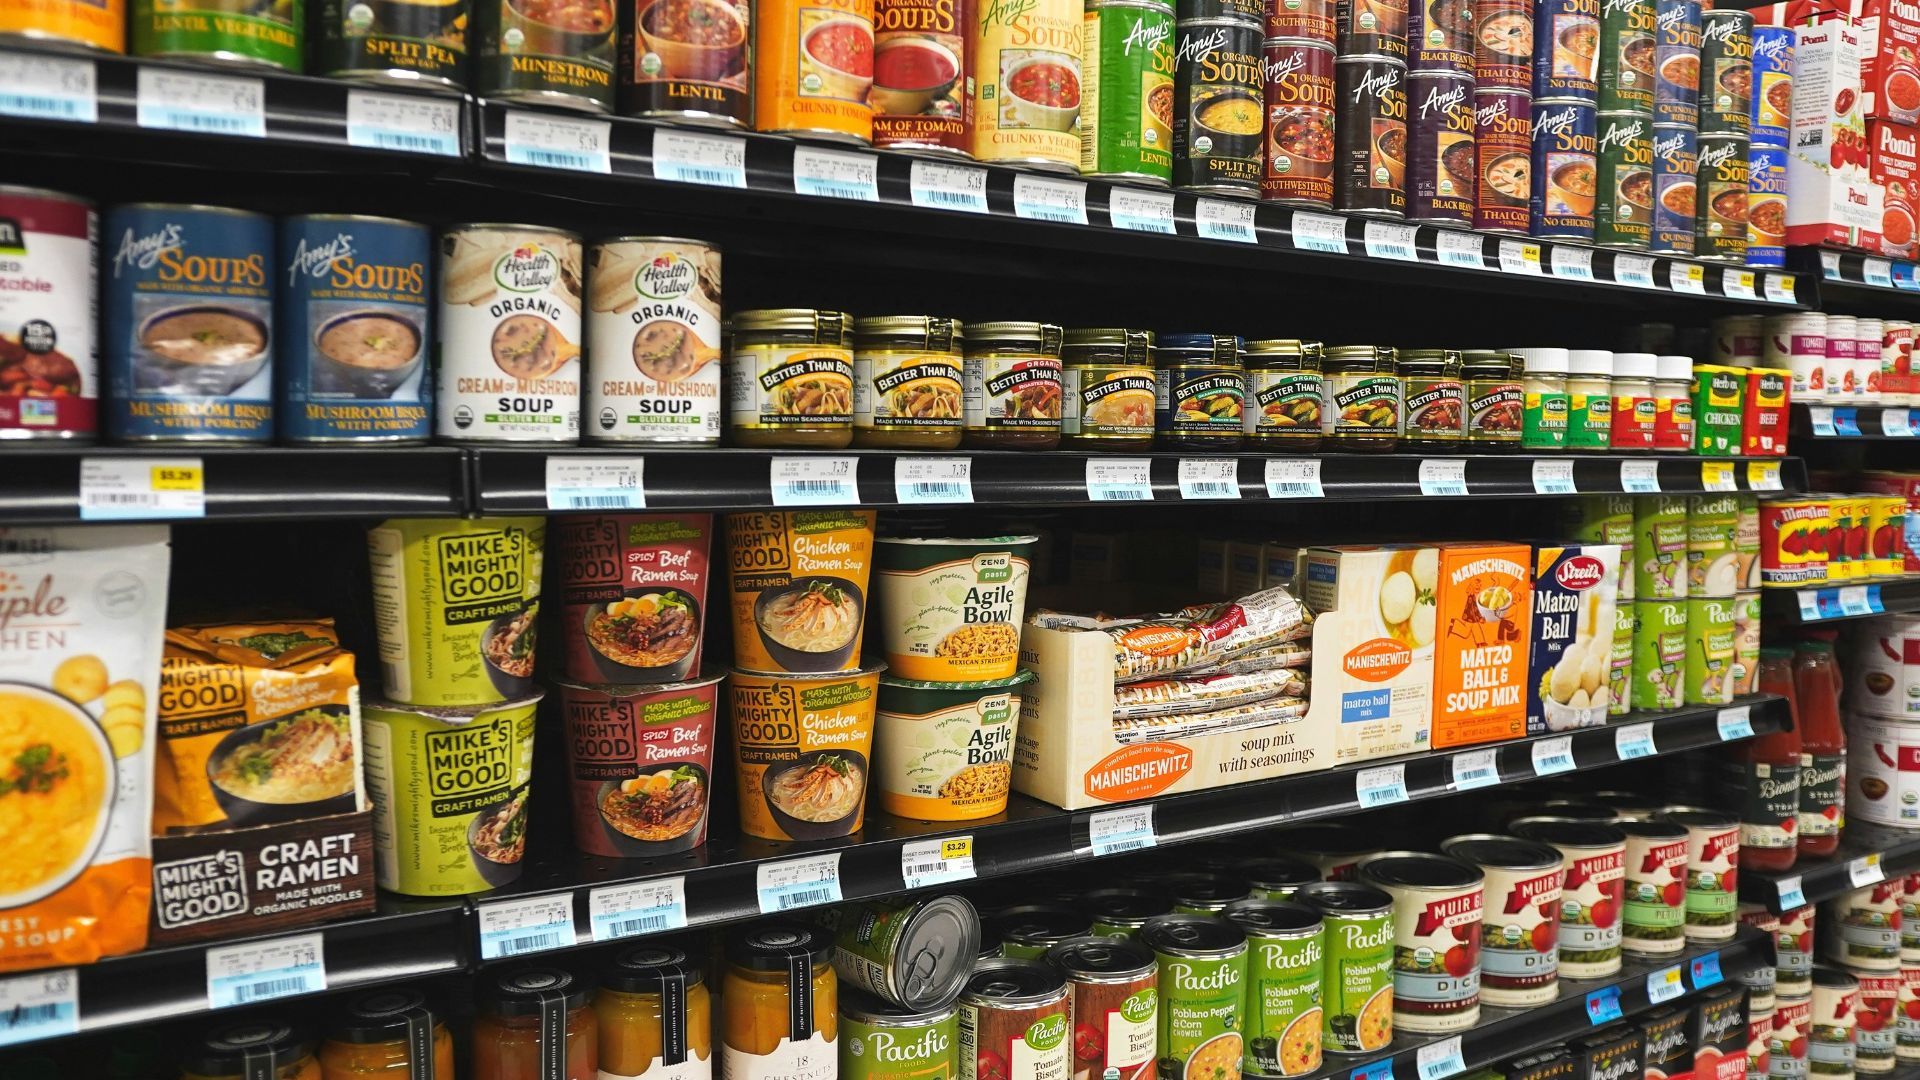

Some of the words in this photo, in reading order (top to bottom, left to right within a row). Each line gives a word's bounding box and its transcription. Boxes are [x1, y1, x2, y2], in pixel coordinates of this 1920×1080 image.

[1011, 15, 1082, 57] SOUPS
[1702, 17, 1743, 48] Amy's
[366, 38, 419, 57] SPLIT
[427, 43, 455, 64] PEA
[1753, 34, 1788, 57] Amy's
[1420, 51, 1447, 62] BLACK
[512, 56, 608, 86] MINESTRONE
[668, 82, 726, 101] LENTIL
[1353, 68, 1401, 104] Amy's
[792, 101, 838, 116] CHUNKY
[896, 121, 913, 131] OF
[915, 122, 964, 135] TOMATO
[1599, 120, 1643, 153] Amy's
[992, 132, 1043, 144] CHUNKY
[1210, 159, 1245, 171] SPLIT
[1247, 161, 1261, 174] PEA
[856, 172, 873, 185] 5.19
[967, 175, 982, 188] 5.19
[1261, 180, 1320, 194] SOUTHWESTERN
[1064, 195, 1078, 209] 5.19
[1432, 199, 1457, 210] BLACK
[1240, 210, 1252, 219] 5.19
[1483, 211, 1511, 221] THAI
[159, 247, 266, 286] SOUPS
[644, 263, 688, 281] Health
[331, 257, 423, 294] SOUPS
[654, 278, 692, 296] Valley
[490, 298, 561, 321] ORGANIC
[632, 305, 699, 326] ORGANIC
[762, 364, 804, 388] BETTER
[806, 360, 834, 373] THAN
[878, 370, 918, 394] BETTER
[989, 374, 1030, 394] BETTER
[1031, 369, 1052, 380] THAN
[458, 378, 503, 394] CREAM
[603, 380, 646, 396] CREAM
[657, 381, 717, 399] MUSHROOM
[1085, 383, 1121, 402] BETTER
[1123, 379, 1144, 390] THAN
[1176, 382, 1212, 399] BETTER
[1213, 378, 1235, 389] THAN
[499, 398, 553, 413] SOUP
[640, 400, 692, 414] SOUP
[1409, 394, 1439, 409] BETTER
[497, 415, 530, 423] GLUTEN
[532, 415, 553, 423] FREE
[639, 416, 669, 424] GLUTEN
[671, 416, 693, 424] FREE
[1704, 414, 1741, 425] CHICKEN
[1759, 414, 1779, 425] BEEF
[160, 470, 192, 481] $5.29
[832, 462, 849, 473] 7.79
[952, 465, 967, 476] 7.79
[1221, 466, 1233, 477] 5.69
[1134, 474, 1147, 484] 5.99
[445, 533, 520, 559] MIKE'S
[793, 537, 850, 556] Chicken
[447, 553, 520, 577] MIGHTY
[659, 551, 691, 567] Beef
[733, 548, 785, 568] GOOD
[797, 555, 843, 571] Ramen
[980, 558, 1006, 566] ZENB
[631, 568, 679, 582] Ramen
[680, 570, 699, 583] Soup
[985, 570, 1007, 579] pasta
[1451, 558, 1526, 585] MANISCHEWITZ
[450, 570, 520, 598] GOOD
[964, 586, 1014, 607] Agile
[1535, 591, 1578, 614] Matzo
[447, 609, 487, 621] CRAFT
[488, 602, 522, 615] RAMEN
[964, 605, 1012, 624] Bowl
[1542, 615, 1569, 641] Ball
[1548, 643, 1561, 651] Mix
[980, 657, 1001, 665] STREET
[1346, 650, 1411, 670] MANISCHEWITZ
[1460, 646, 1513, 669] MATZO
[1463, 669, 1499, 690] BALL
[1500, 670, 1508, 684] &
[159, 683, 237, 711] GOOD
[735, 692, 789, 707] MIKE'S
[985, 699, 1006, 708] ZENB
[1344, 698, 1371, 710] matzo
[1373, 695, 1389, 707] ball
[1446, 692, 1489, 713] SOUP
[1492, 685, 1520, 707] MIX
[737, 709, 792, 724] MIGHTY
[803, 711, 857, 730] Chicken
[987, 711, 1007, 720] pasta
[1360, 709, 1373, 717] mix
[572, 724, 628, 738] MIGHTY
[643, 730, 669, 741] SPICY
[672, 725, 702, 743] Beef
[740, 724, 793, 741] GOOD
[806, 730, 849, 746] Ramen
[850, 731, 867, 743] Soup
[968, 727, 1011, 748] Agile
[1115, 731, 1139, 739] Nutrition
[432, 727, 509, 754] MIKE'S
[575, 738, 630, 758] GOOD
[1241, 738, 1270, 761] soup
[1272, 731, 1295, 746] mix
[434, 745, 509, 771] MIGHTY
[645, 744, 690, 760] Ramen
[691, 744, 707, 756] Soup
[766, 750, 798, 760] RAMEN
[967, 745, 1009, 765] Bowl
[1219, 756, 1247, 775] with
[1250, 748, 1315, 771] seasonings
[436, 765, 508, 791] GOOD
[1090, 754, 1189, 792] MANISCHEWITZ
[434, 799, 473, 814] CRAFT
[474, 791, 509, 807] RAMEN
[952, 798, 981, 806] MEXICAN
[1134, 820, 1147, 831] 2.39
[259, 833, 355, 867] CRAFT
[947, 842, 966, 852] $3.29
[1656, 845, 1681, 860] MUIR
[159, 858, 238, 886] MIKE'S
[257, 855, 359, 891] RAMEN
[820, 869, 835, 881] 2.79
[1580, 859, 1613, 875] MUIR
[162, 875, 240, 902] MIGHTY
[276, 888, 309, 901] MADE
[311, 883, 342, 897] WITH
[1522, 881, 1555, 898] MUIR
[165, 892, 241, 922] GOOD
[253, 901, 308, 916] ORGANIC
[309, 889, 363, 906] NOODLES
[655, 896, 673, 907] 2.79
[1434, 901, 1469, 919] MUIR
[547, 912, 567, 924] 2.79
[1259, 941, 1322, 969] Pacific
[1168, 964, 1239, 991] Pacific
[1345, 966, 1376, 976] Poblano
[1353, 976, 1371, 985] Corn
[1265, 987, 1299, 997] Poblano
[1265, 998, 1271, 1006] &
[1273, 997, 1293, 1007] Corn
[1173, 1009, 1208, 1018] Poblano
[1210, 1004, 1235, 1017] Pepper
[1031, 1021, 1067, 1043] Pacific
[1173, 1020, 1180, 1028] &
[1181, 1020, 1202, 1028] Corn
[1702, 1013, 1743, 1039] Imagine
[867, 1029, 949, 1063] Pacific
[796, 1056, 809, 1067] 18
[1034, 1056, 1064, 1071] Tomato
[1716, 1058, 1745, 1073] TOMATO
